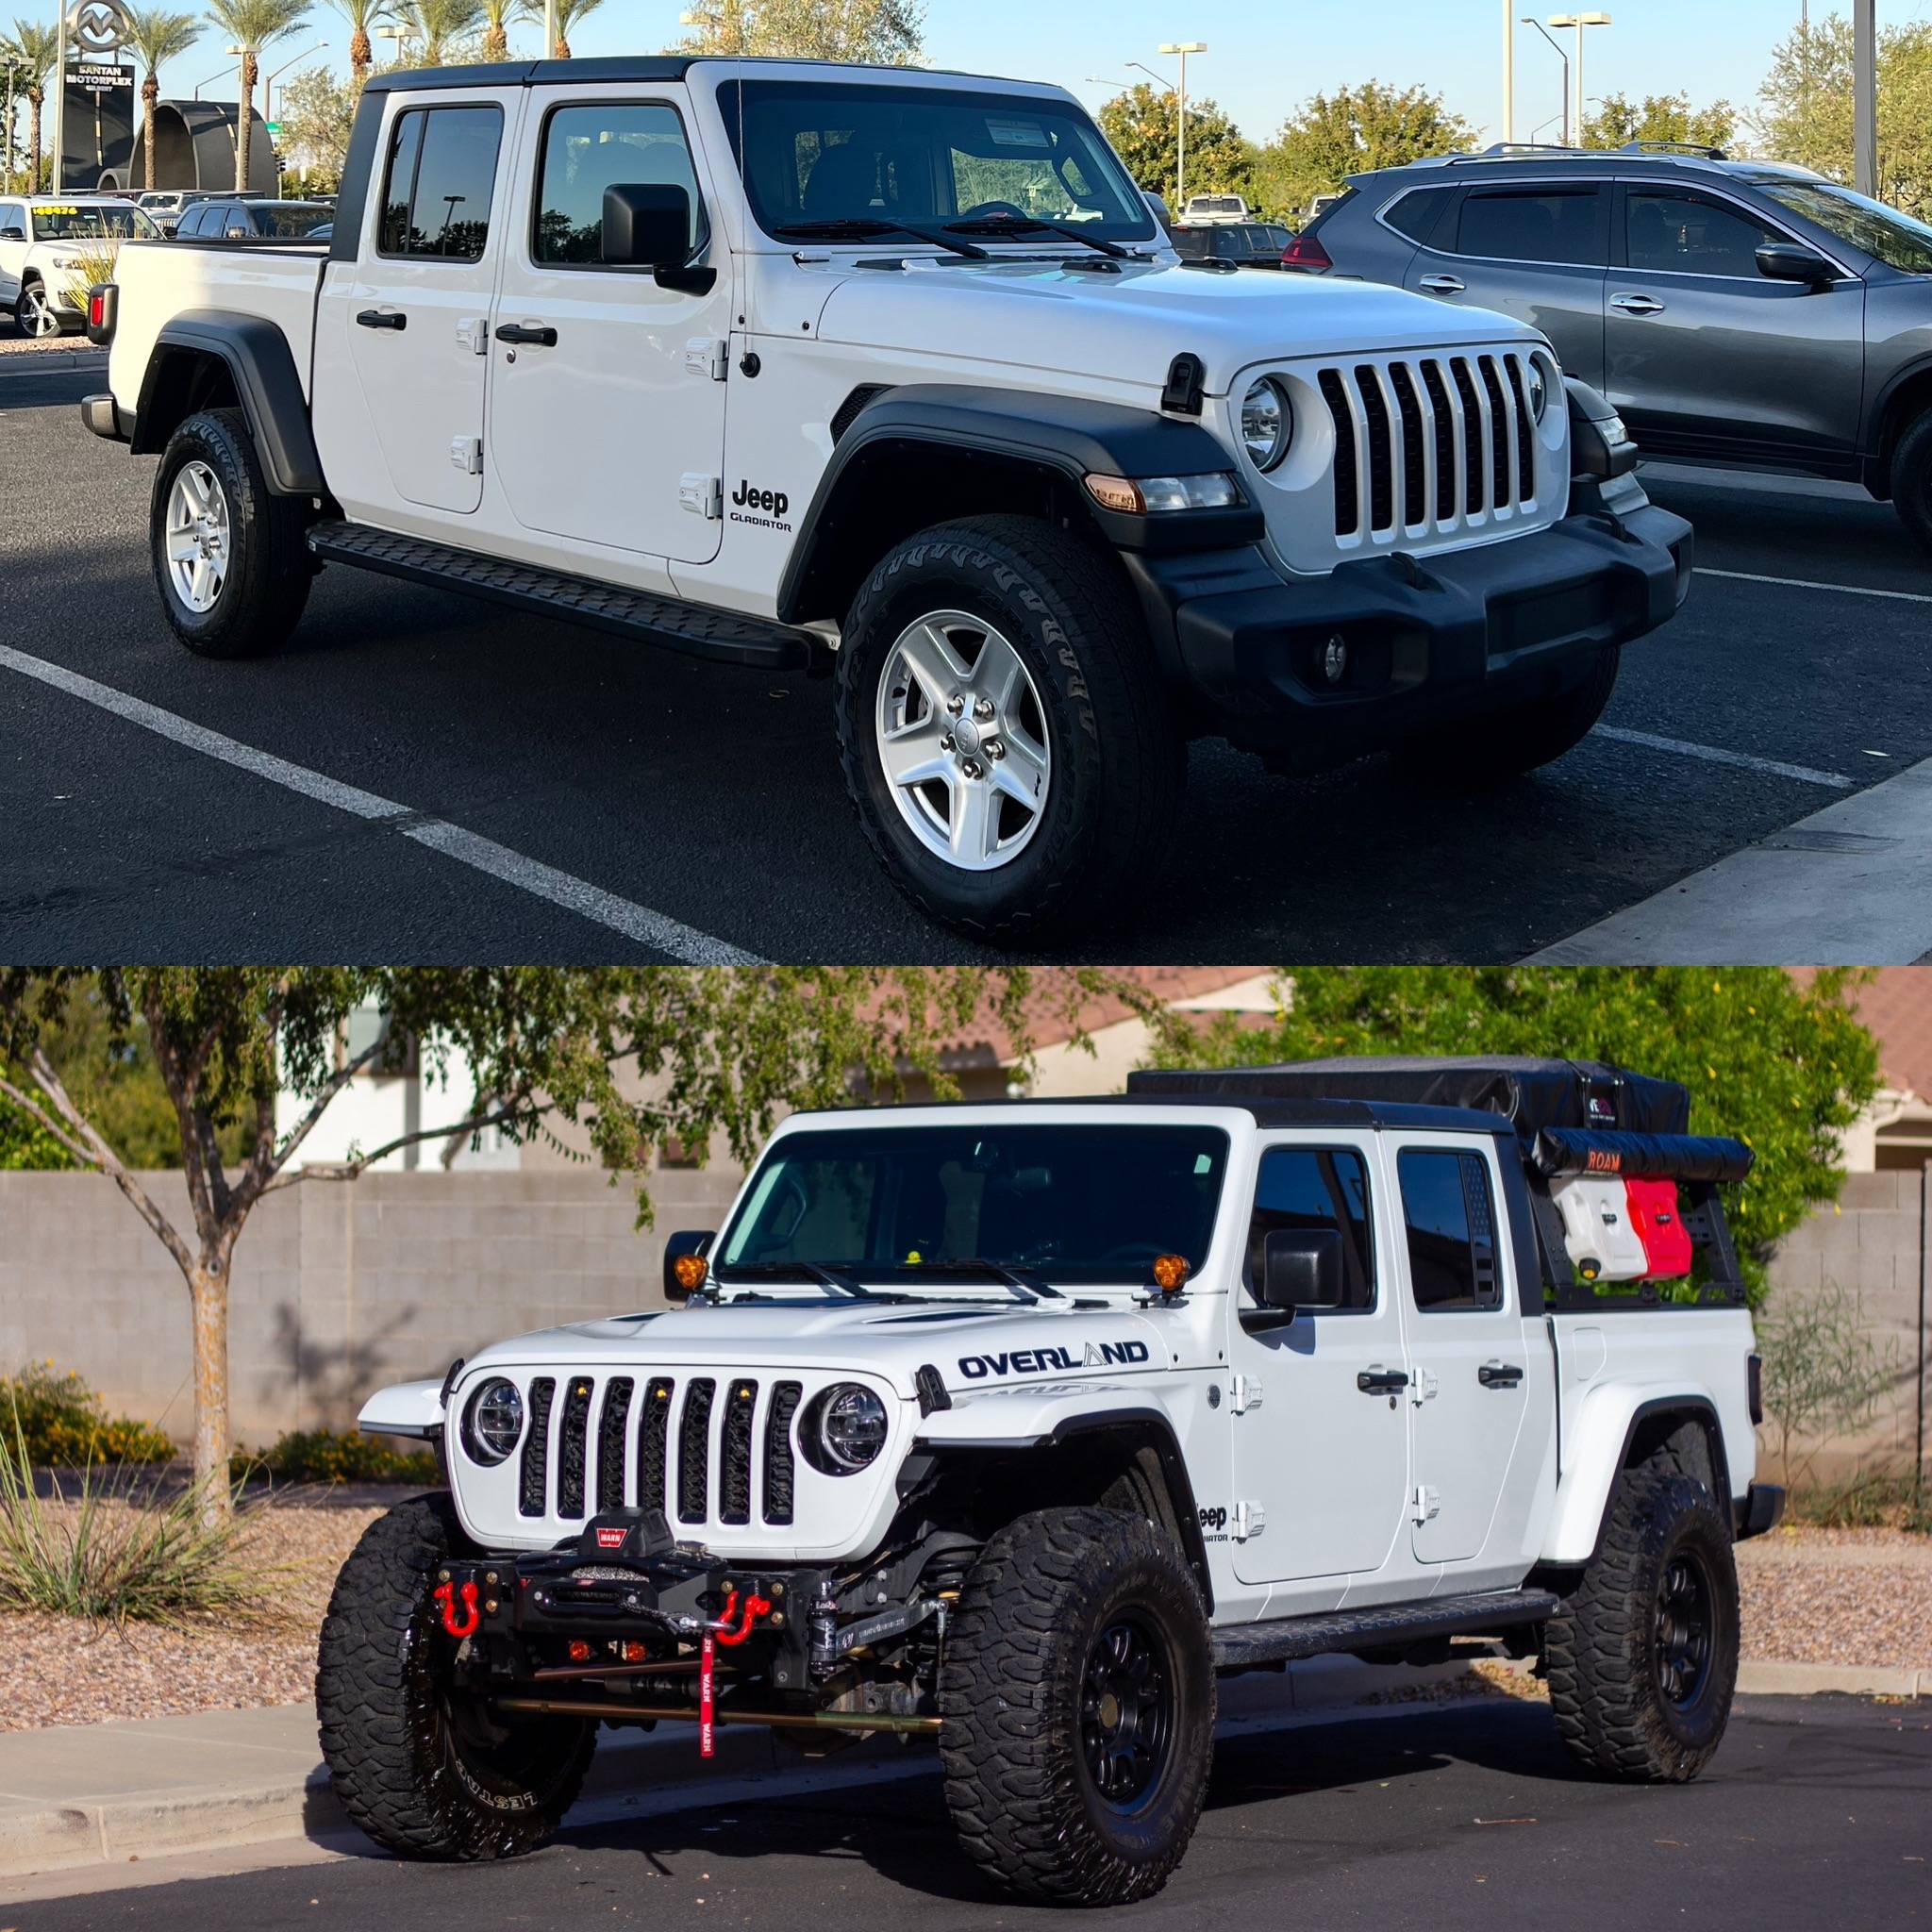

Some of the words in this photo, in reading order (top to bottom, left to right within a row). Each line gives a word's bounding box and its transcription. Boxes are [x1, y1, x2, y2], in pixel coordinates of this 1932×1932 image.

[66, 75, 132, 86] MOTORPLEX
[78, 65, 122, 75] SANTAN
[732, 479, 789, 518] Jeep
[730, 512, 792, 533] GLADIATOR
[1588, 1151, 1621, 1171] ROAM
[958, 1341, 1149, 1379] OVERLAND
[1196, 1503, 1227, 1531] eep
[600, 1534, 622, 1542] WARN
[703, 1674, 711, 1703] WARN
[703, 1724, 712, 1753] WARN
